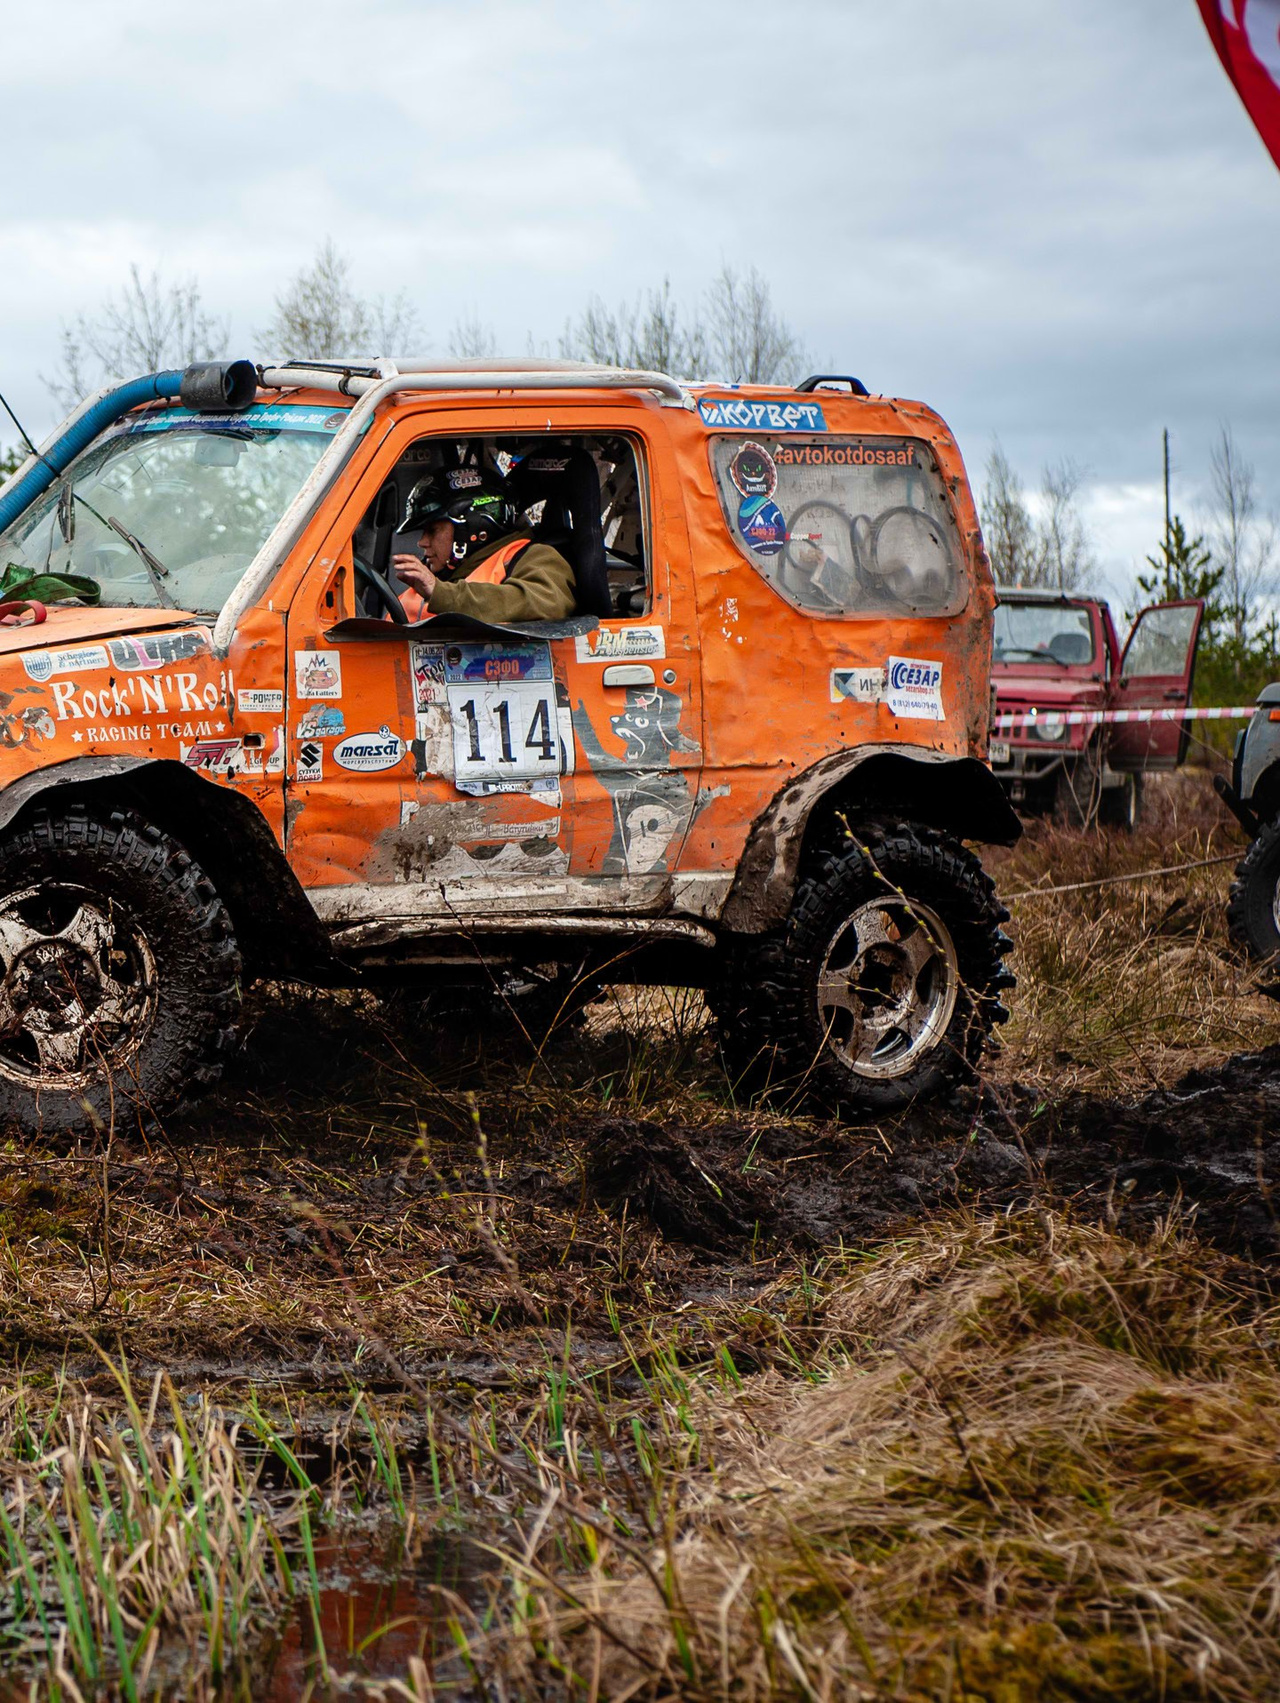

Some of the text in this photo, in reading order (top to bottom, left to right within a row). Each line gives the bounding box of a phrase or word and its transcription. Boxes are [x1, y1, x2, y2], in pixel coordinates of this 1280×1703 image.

[484, 658, 520, 676] СЗФО
[86, 721, 212, 742] RACING TEAM
[459, 699, 557, 763] 114
